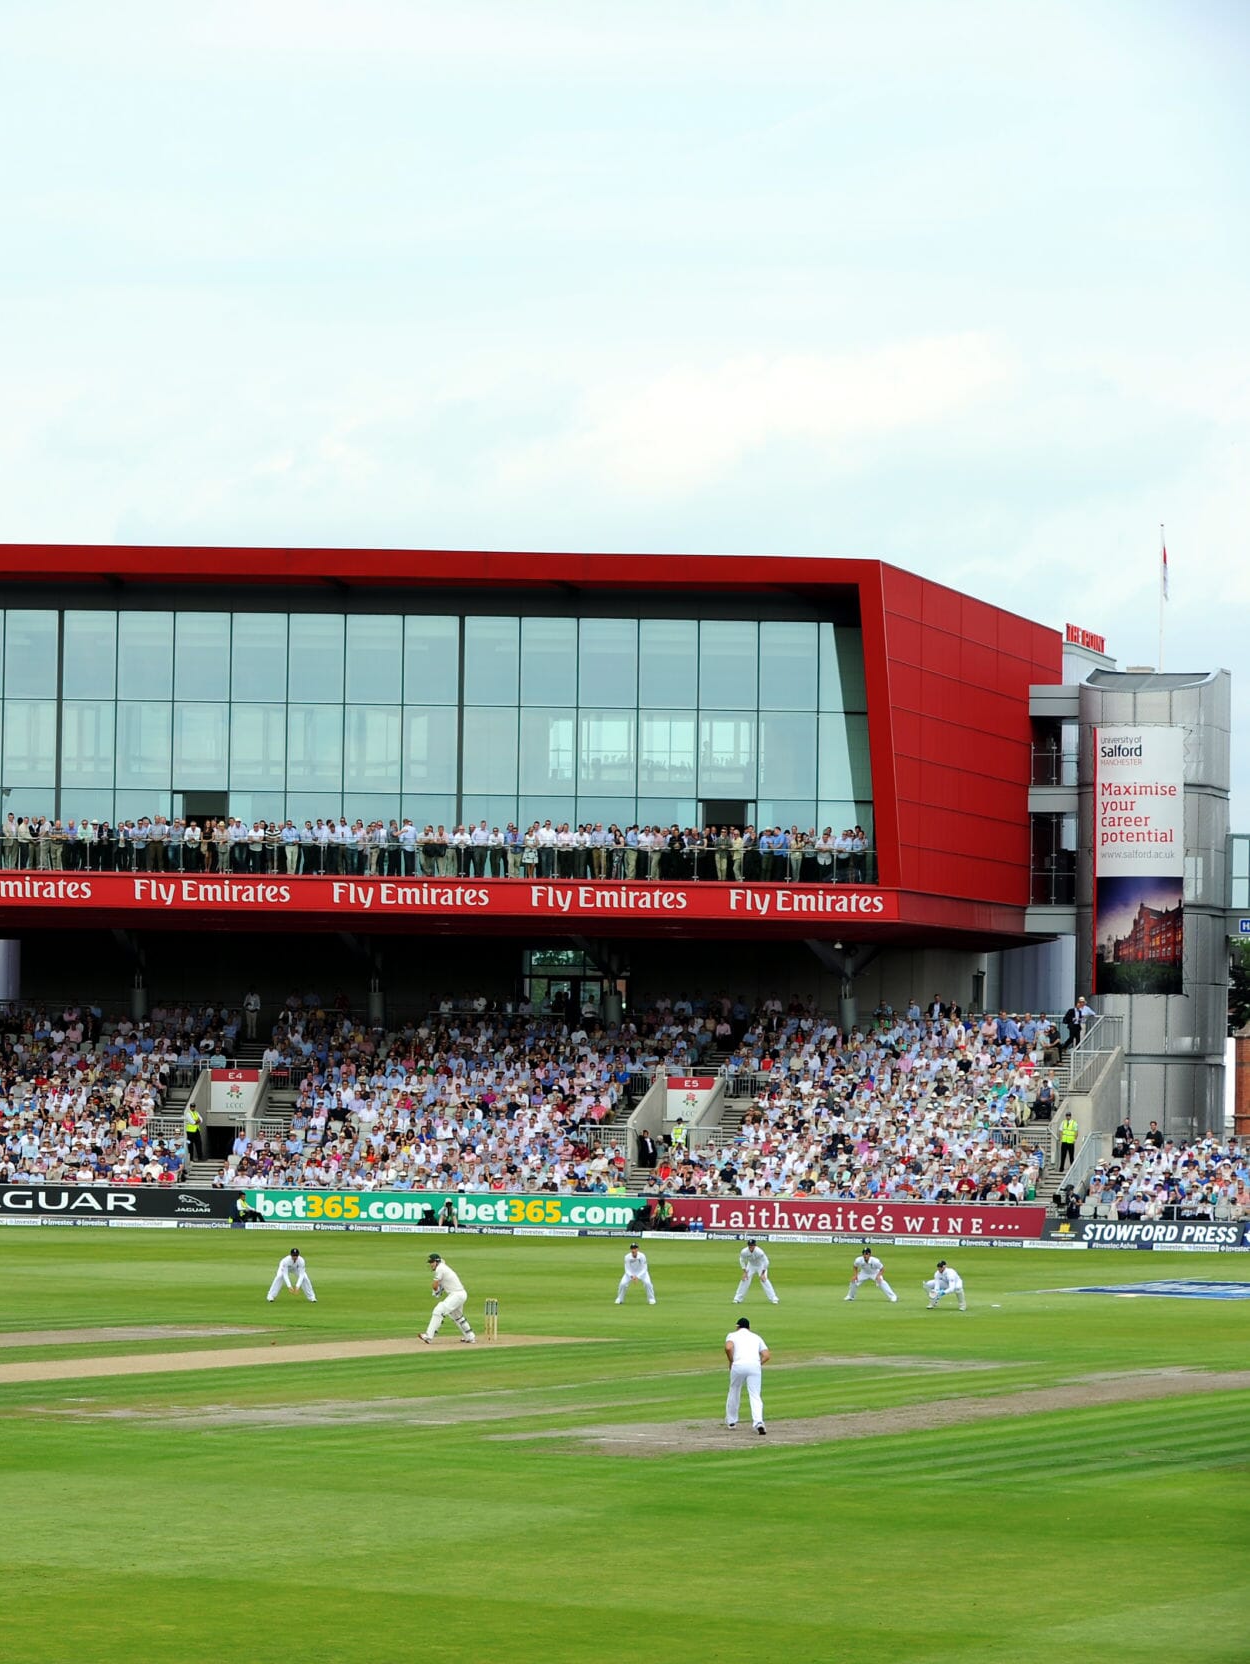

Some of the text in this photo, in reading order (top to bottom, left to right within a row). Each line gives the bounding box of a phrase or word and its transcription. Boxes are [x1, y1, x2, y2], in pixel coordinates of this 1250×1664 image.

[1101, 744, 1142, 758] Salford
[1101, 758, 1142, 766] MANCHESTER
[1101, 782, 1177, 796] Maximise
[1101, 800, 1136, 814] your
[1101, 815, 1151, 828] career
[1101, 829, 1174, 846] potential
[1101, 850, 1175, 859] www.salford.ac.uk
[134, 880, 290, 905] Fly Emirates
[333, 883, 489, 908] Fly Emirates
[531, 886, 686, 911] Fly Emirates
[730, 890, 883, 915] Fly Emirates
[256, 1193, 431, 1220] bet365.com
[457, 1197, 634, 1225] bet365.com
[709, 1203, 983, 1235] Laithwaite's WINE
[1082, 1224, 1238, 1244] STOWFORD PRESS
